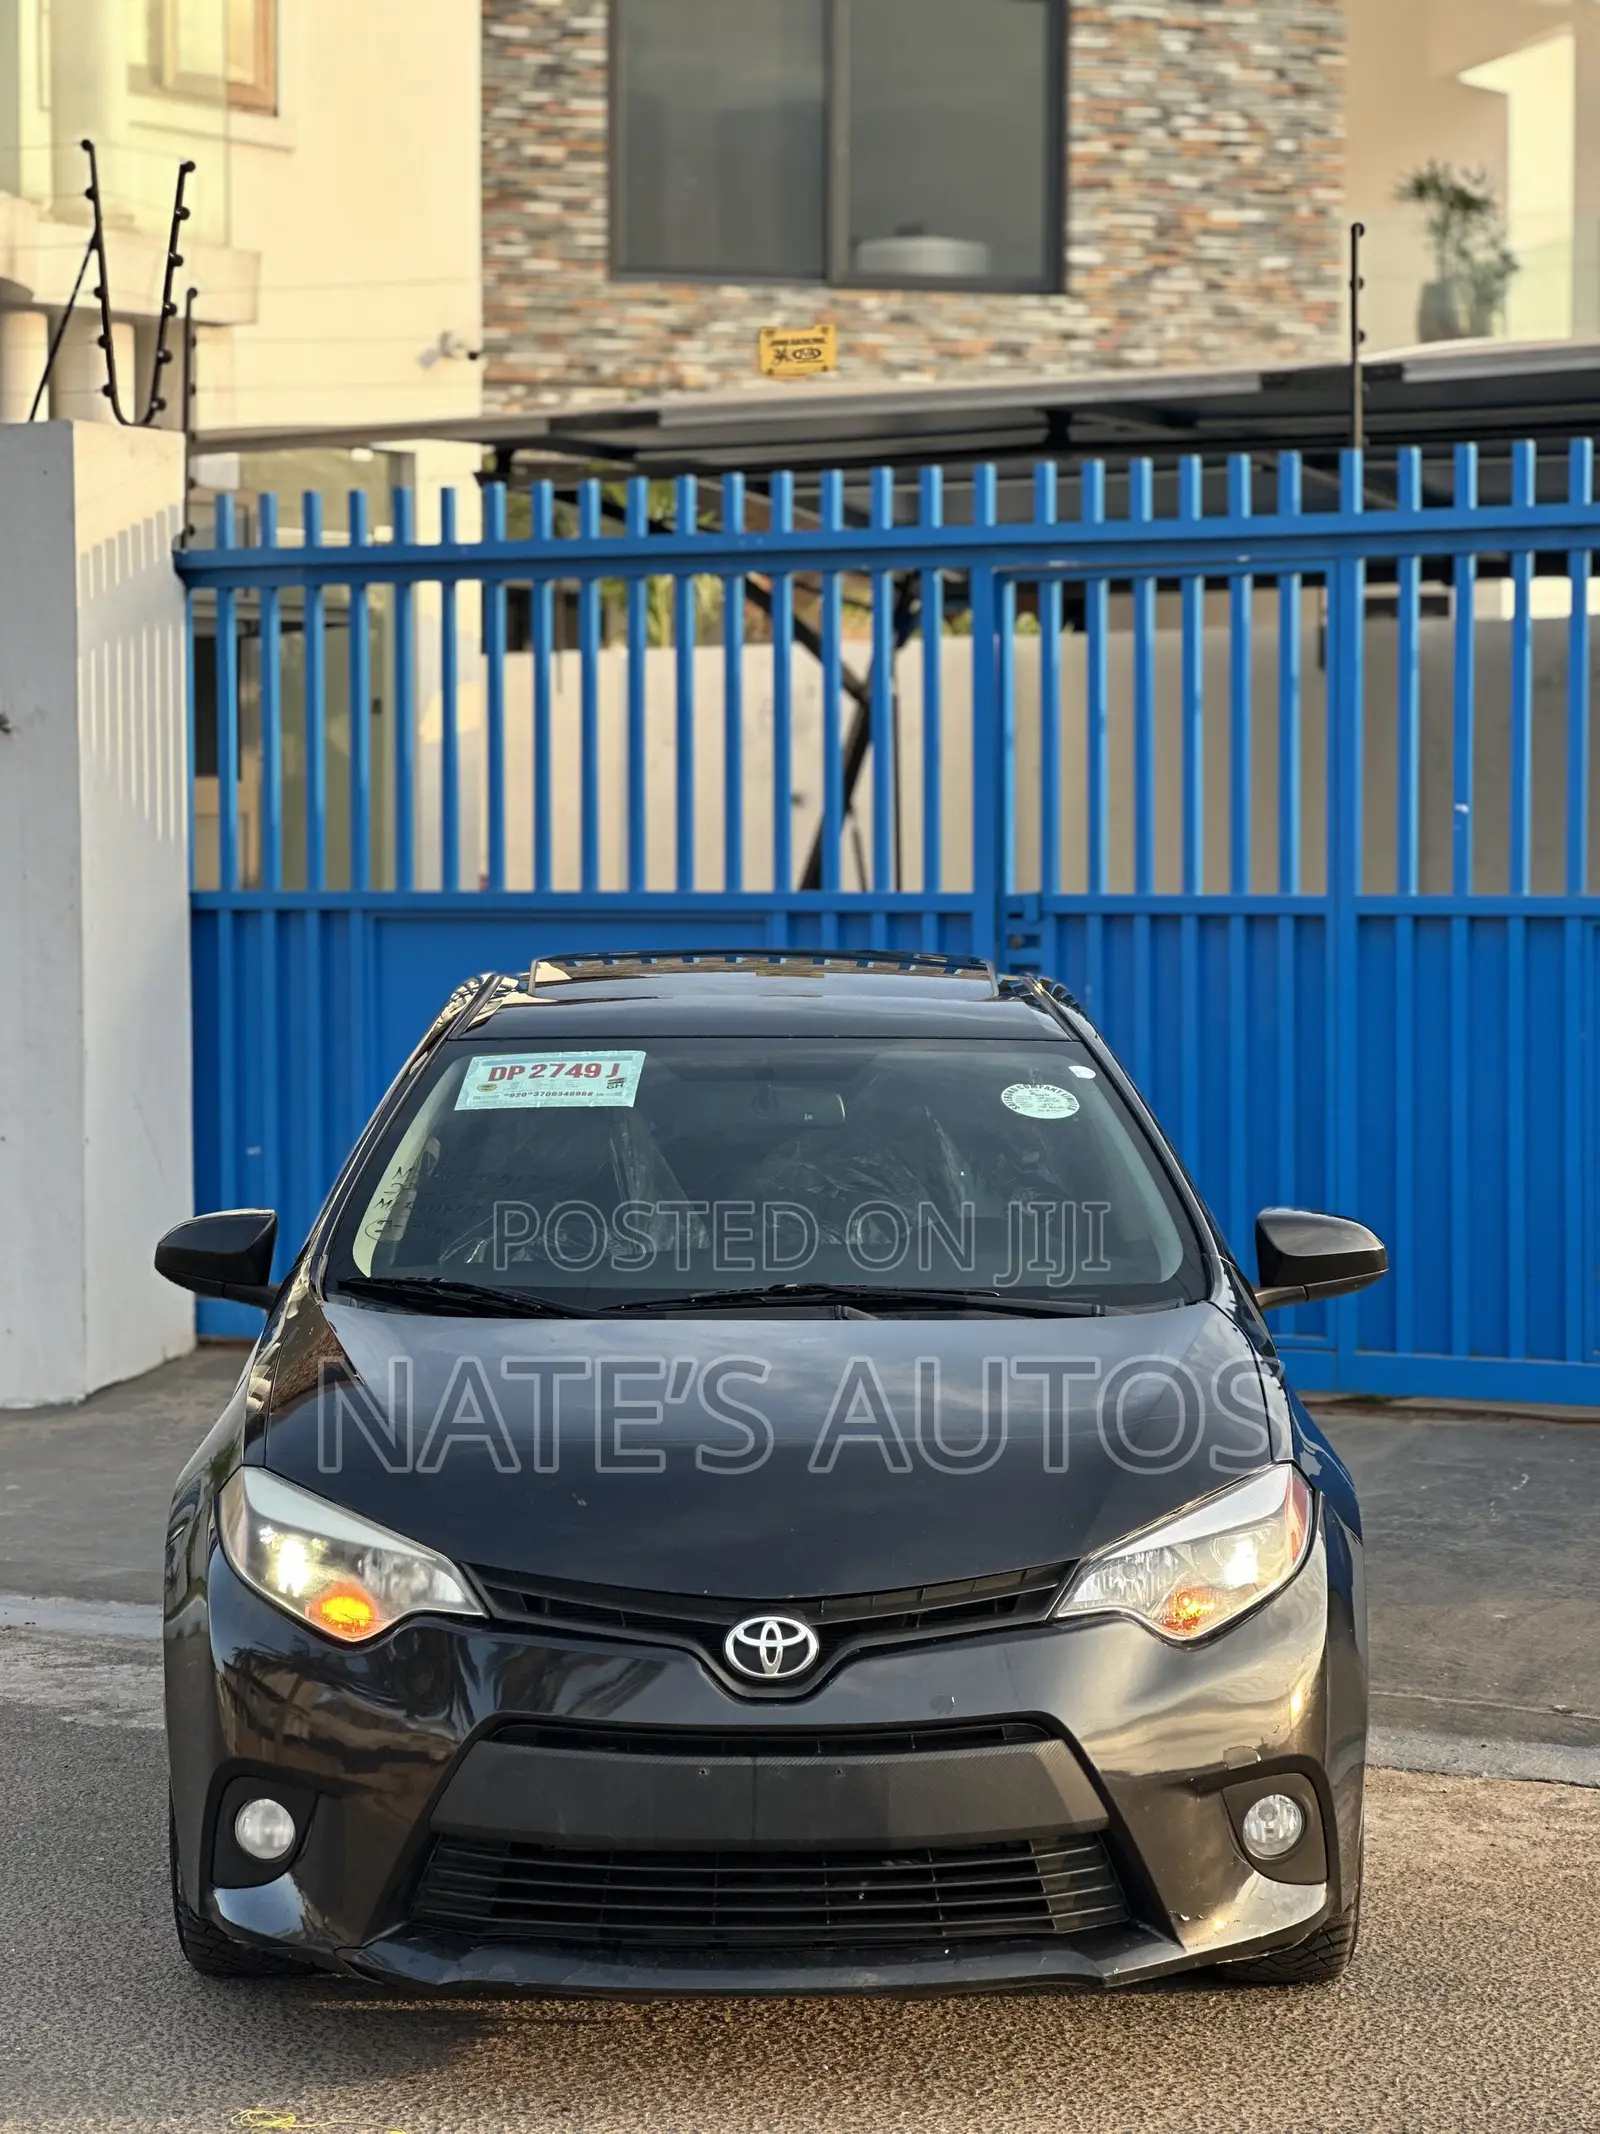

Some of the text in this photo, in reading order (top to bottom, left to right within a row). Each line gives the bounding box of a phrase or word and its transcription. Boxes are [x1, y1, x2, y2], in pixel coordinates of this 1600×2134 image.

[488, 1063, 620, 1082] DP 2749 J
